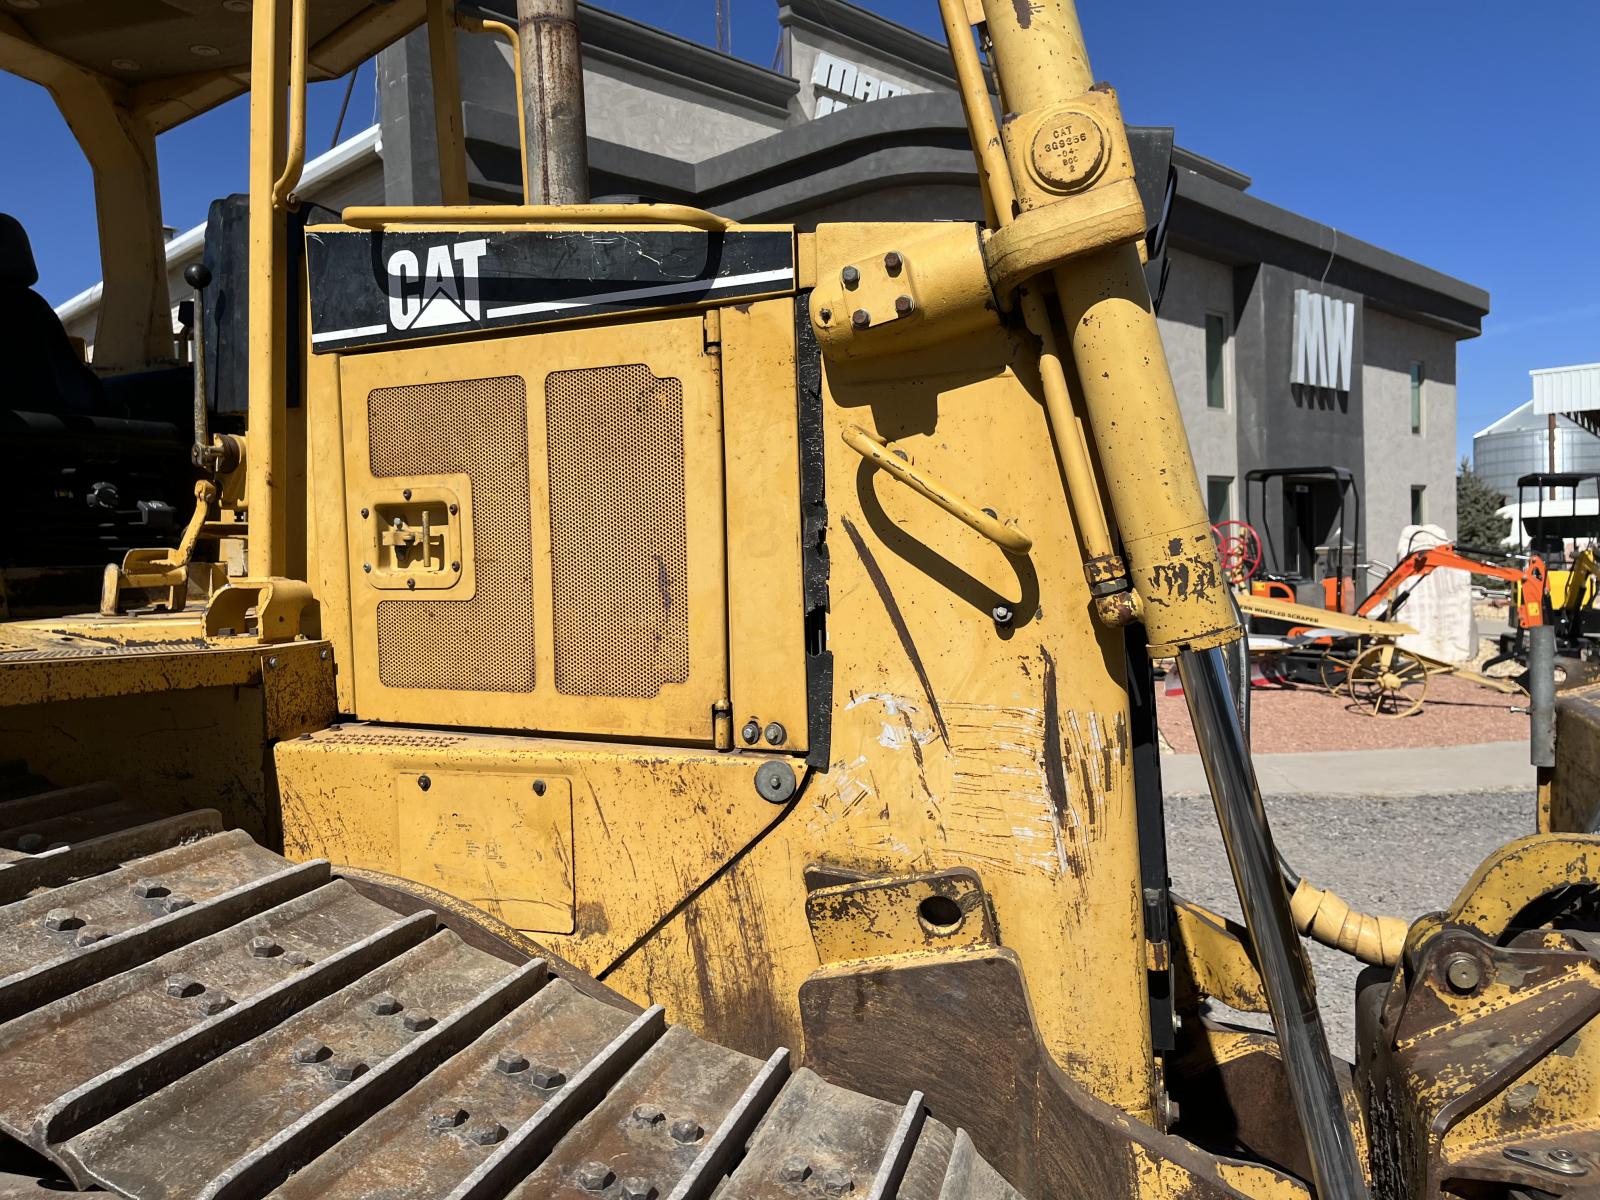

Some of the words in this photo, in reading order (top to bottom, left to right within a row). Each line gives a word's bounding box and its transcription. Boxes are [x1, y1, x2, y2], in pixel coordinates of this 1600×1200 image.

[811, 52, 912, 103] MA
[1053, 125, 1072, 139] CAT
[387, 239, 487, 331] CAT
[1290, 289, 1355, 391] MW
[1254, 608, 1286, 617] WHEELED
